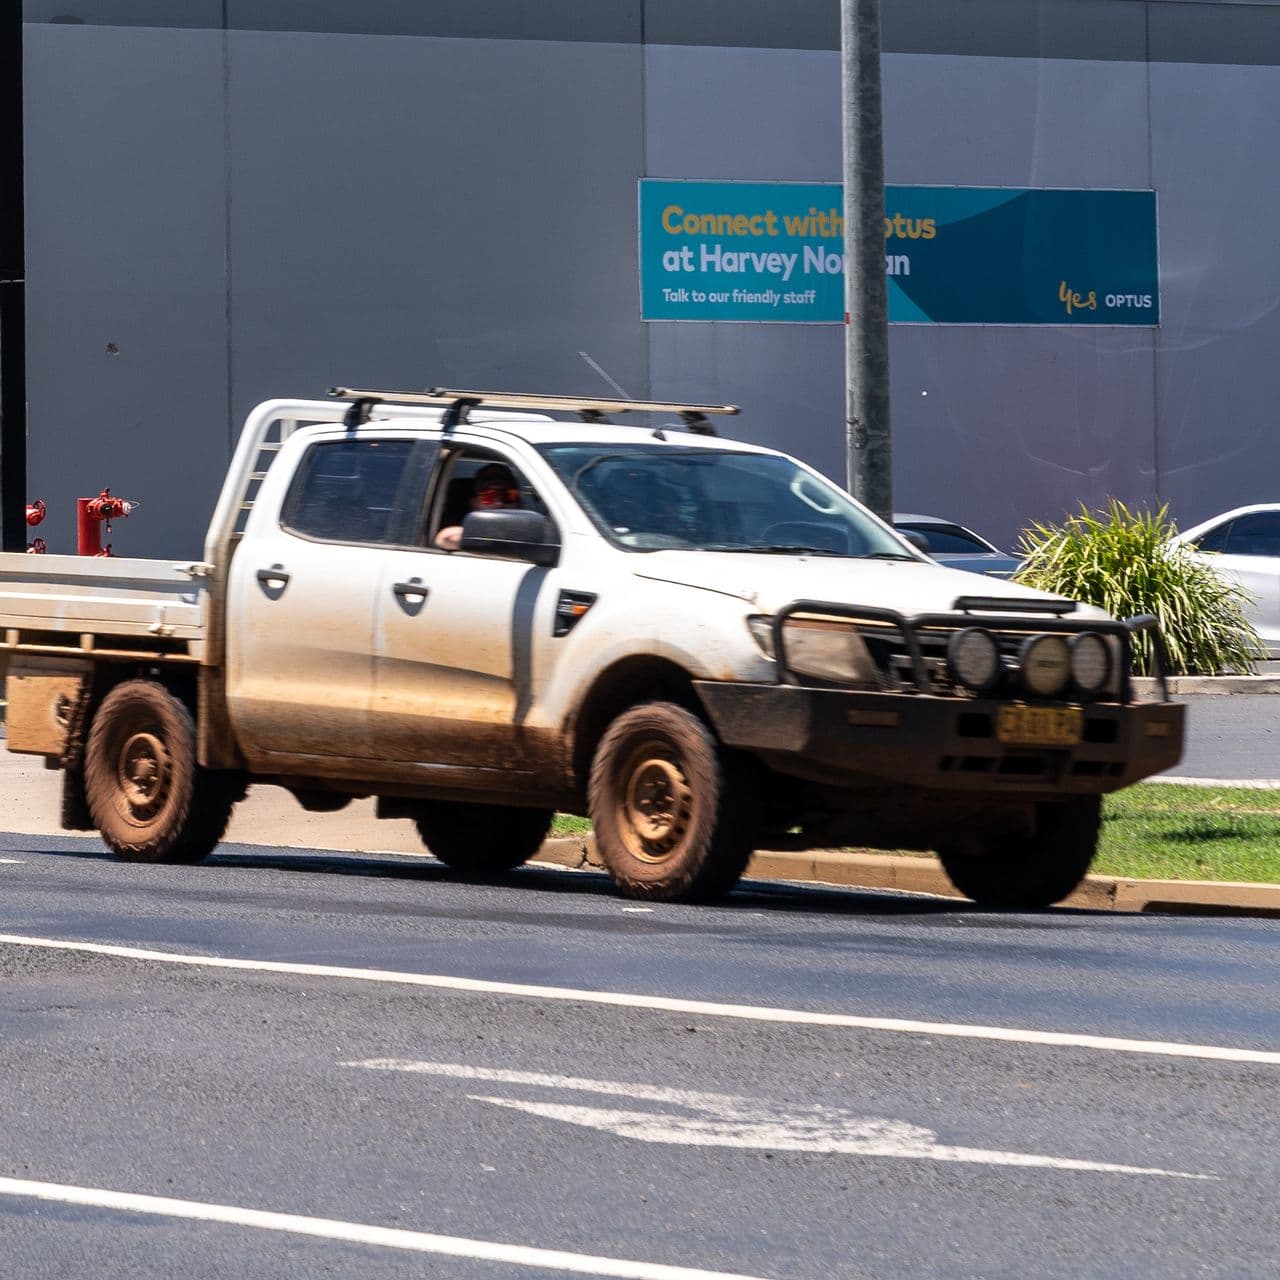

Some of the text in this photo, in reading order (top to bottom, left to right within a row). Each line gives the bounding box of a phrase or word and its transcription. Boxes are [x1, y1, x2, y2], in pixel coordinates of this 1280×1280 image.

[661, 204, 779, 237] Connect
[783, 207, 846, 238] with
[662, 245, 695, 272] at
[700, 243, 798, 281] Harvey
[662, 288, 817, 307] Talk to our friendly staff
[1104, 294, 1153, 308] OPTUS
